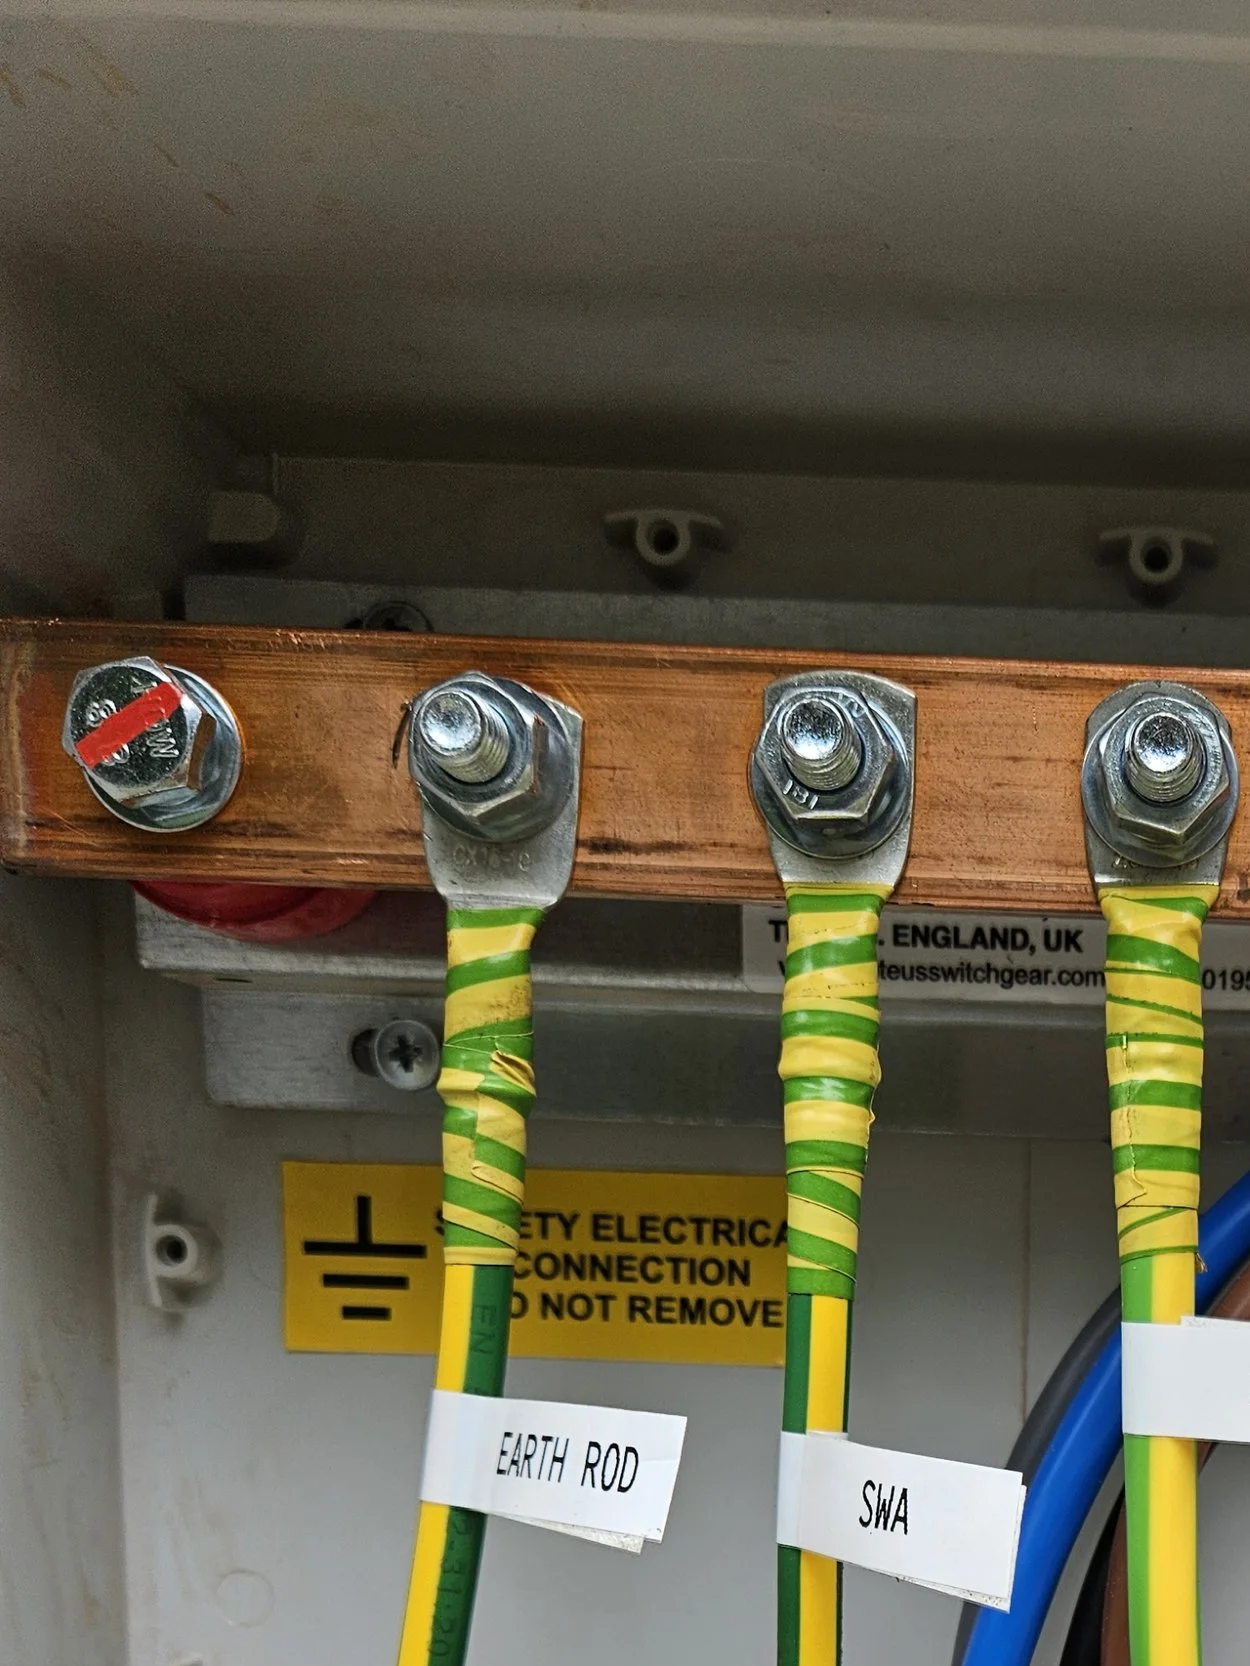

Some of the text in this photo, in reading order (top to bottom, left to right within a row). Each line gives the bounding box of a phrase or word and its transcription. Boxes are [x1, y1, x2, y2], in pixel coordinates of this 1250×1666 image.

[892, 923, 1037, 957] ENGLAND,
[1043, 928, 1084, 954] UK
[779, 959, 1107, 990] teusswitchgear.com
[435, 1210, 788, 1248] ETY ELECTRICA
[512, 1250, 751, 1287] CONNECTION
[540, 1292, 618, 1322] NOT
[628, 1294, 785, 1328] REMOVE
[496, 1431, 640, 1493] EARTH ROD
[858, 1479, 909, 1535] SWA
